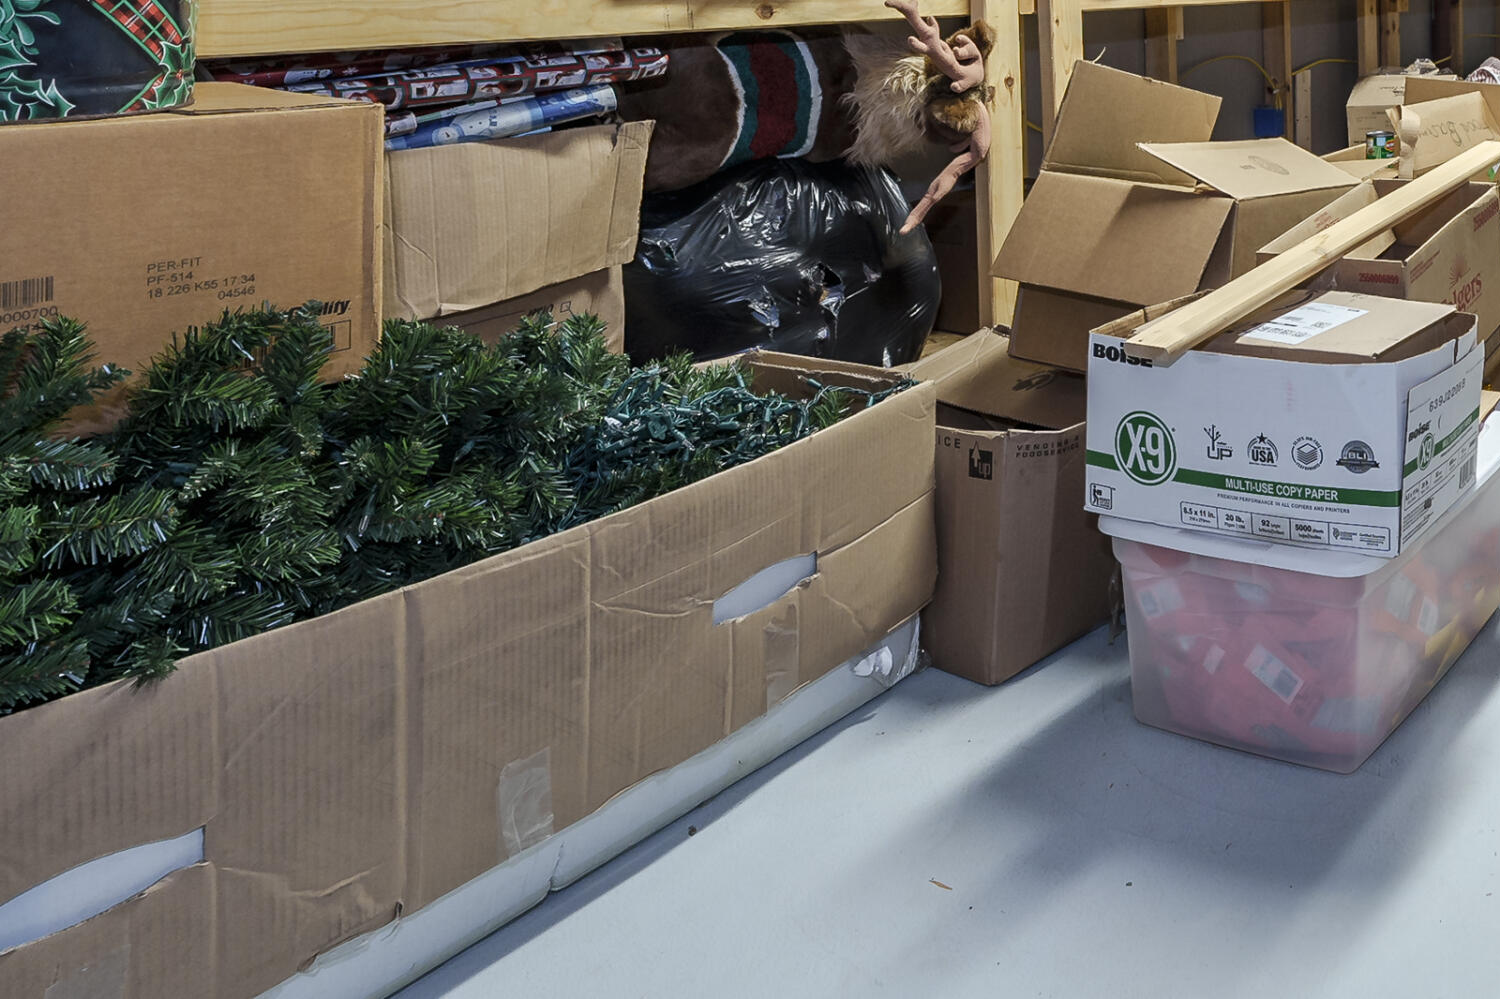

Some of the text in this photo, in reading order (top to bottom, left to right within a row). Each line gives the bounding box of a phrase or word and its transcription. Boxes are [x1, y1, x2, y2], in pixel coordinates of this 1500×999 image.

[147, 256, 202, 274] PER-FIT
[147, 271, 194, 287] PF-514
[148, 286, 163, 299] 18
[167, 283, 191, 297] 226
[218, 286, 255, 300] 04546
[1251, 449, 1274, 466] USA
[1225, 478, 1339, 502] MULTI-USE COPY PAPER
[1239, 495, 1350, 515] PERFORMANCE COPIERS PRINTERS
[1295, 523, 1312, 533] 5000
